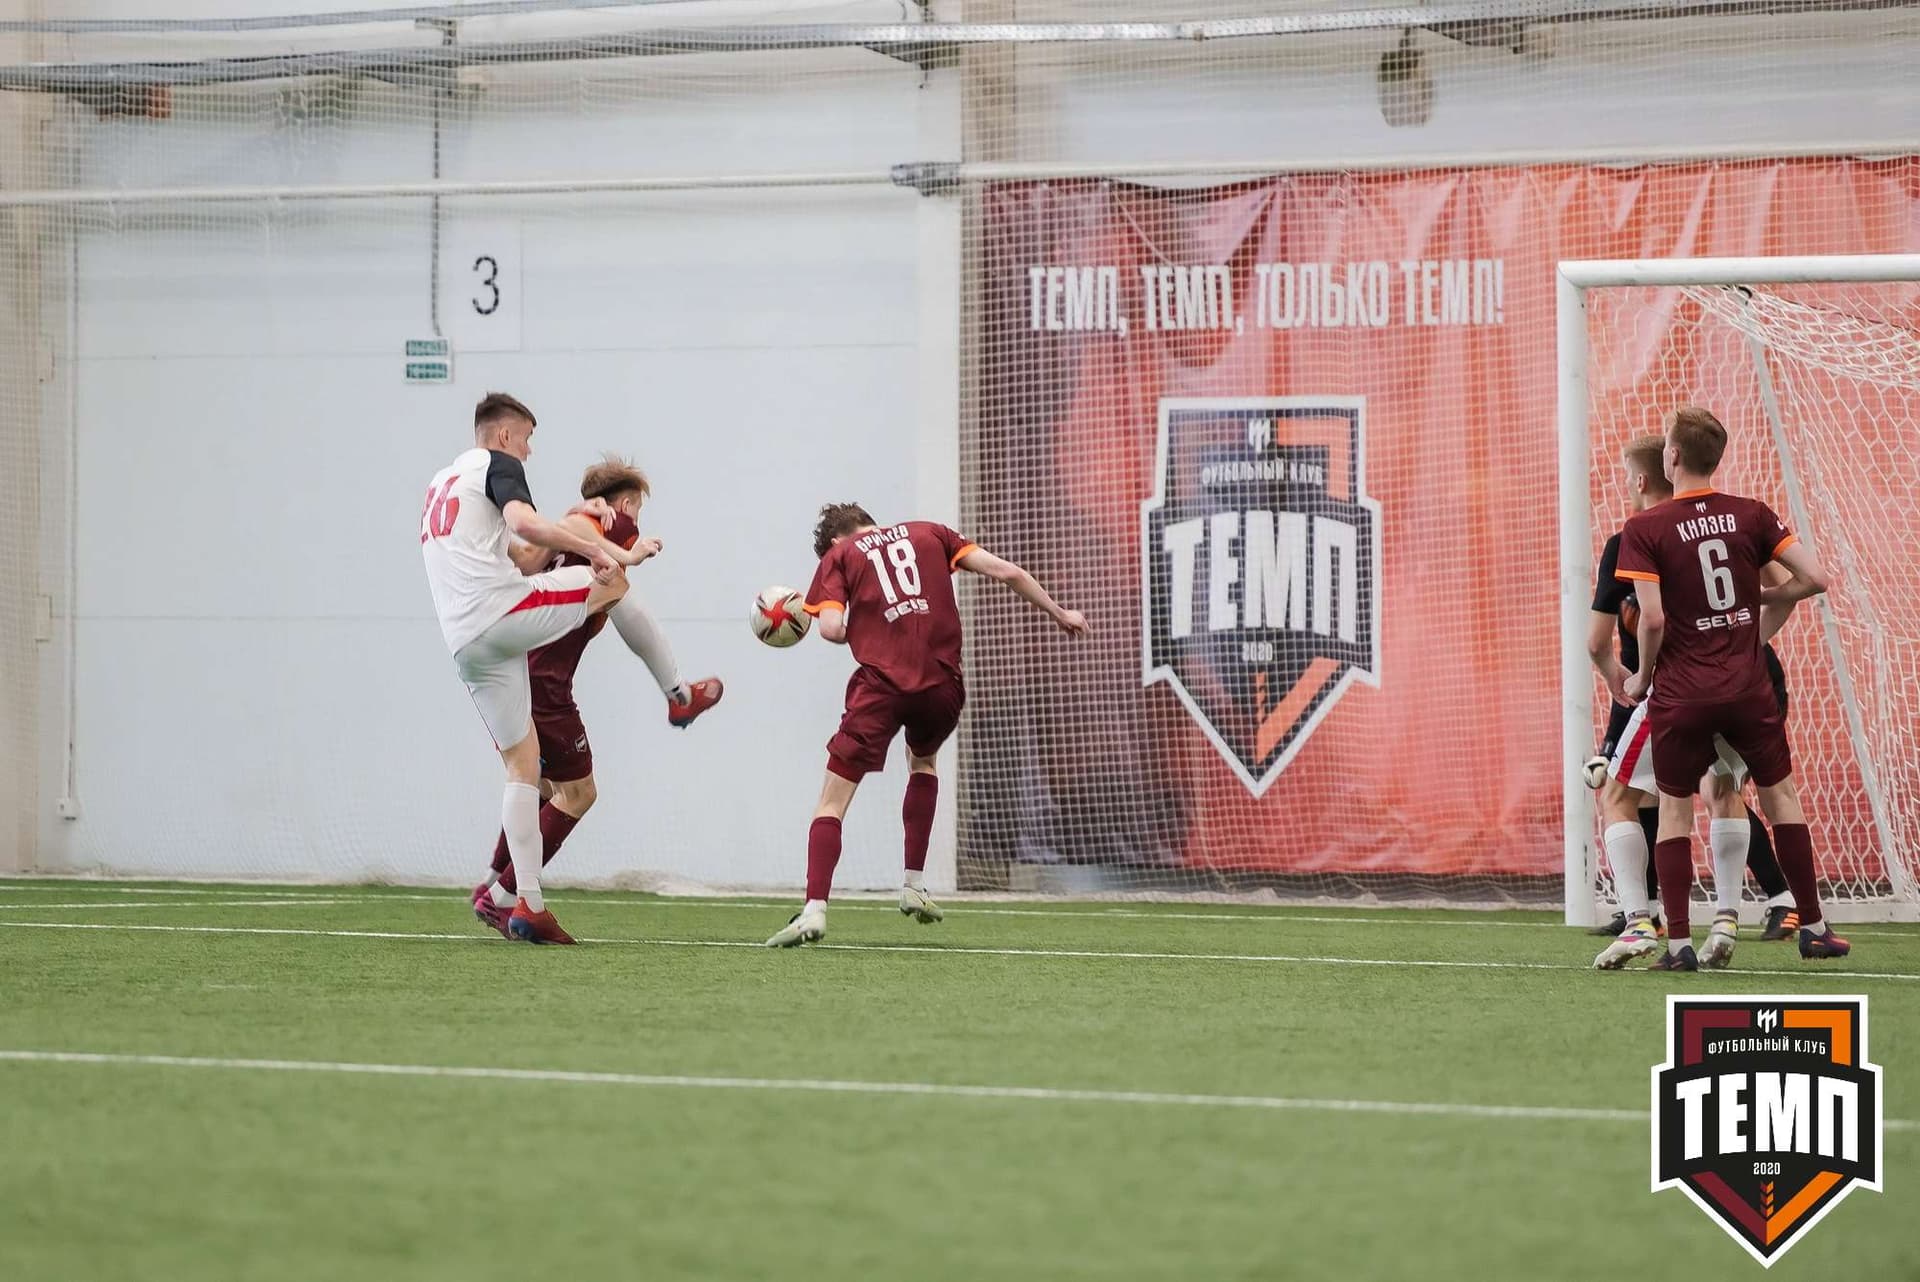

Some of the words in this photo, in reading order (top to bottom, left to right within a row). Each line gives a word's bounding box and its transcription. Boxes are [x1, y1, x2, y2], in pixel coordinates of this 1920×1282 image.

[472, 256, 499, 315] 3
[1029, 264, 1128, 337] ТЕМП,
[1140, 264, 1244, 337] ТЕМП,
[1255, 261, 1389, 329] ТОЛЬКО
[1400, 258, 1504, 327] ТЕМП!
[1289, 461, 1323, 486] КЛУБ
[1676, 513, 1737, 542] КНЯЗЕВ
[866, 538, 921, 605] 18
[1163, 510, 1358, 644] ТЕМП
[1698, 538, 1736, 611] 6
[1241, 641, 1274, 662] 2020
